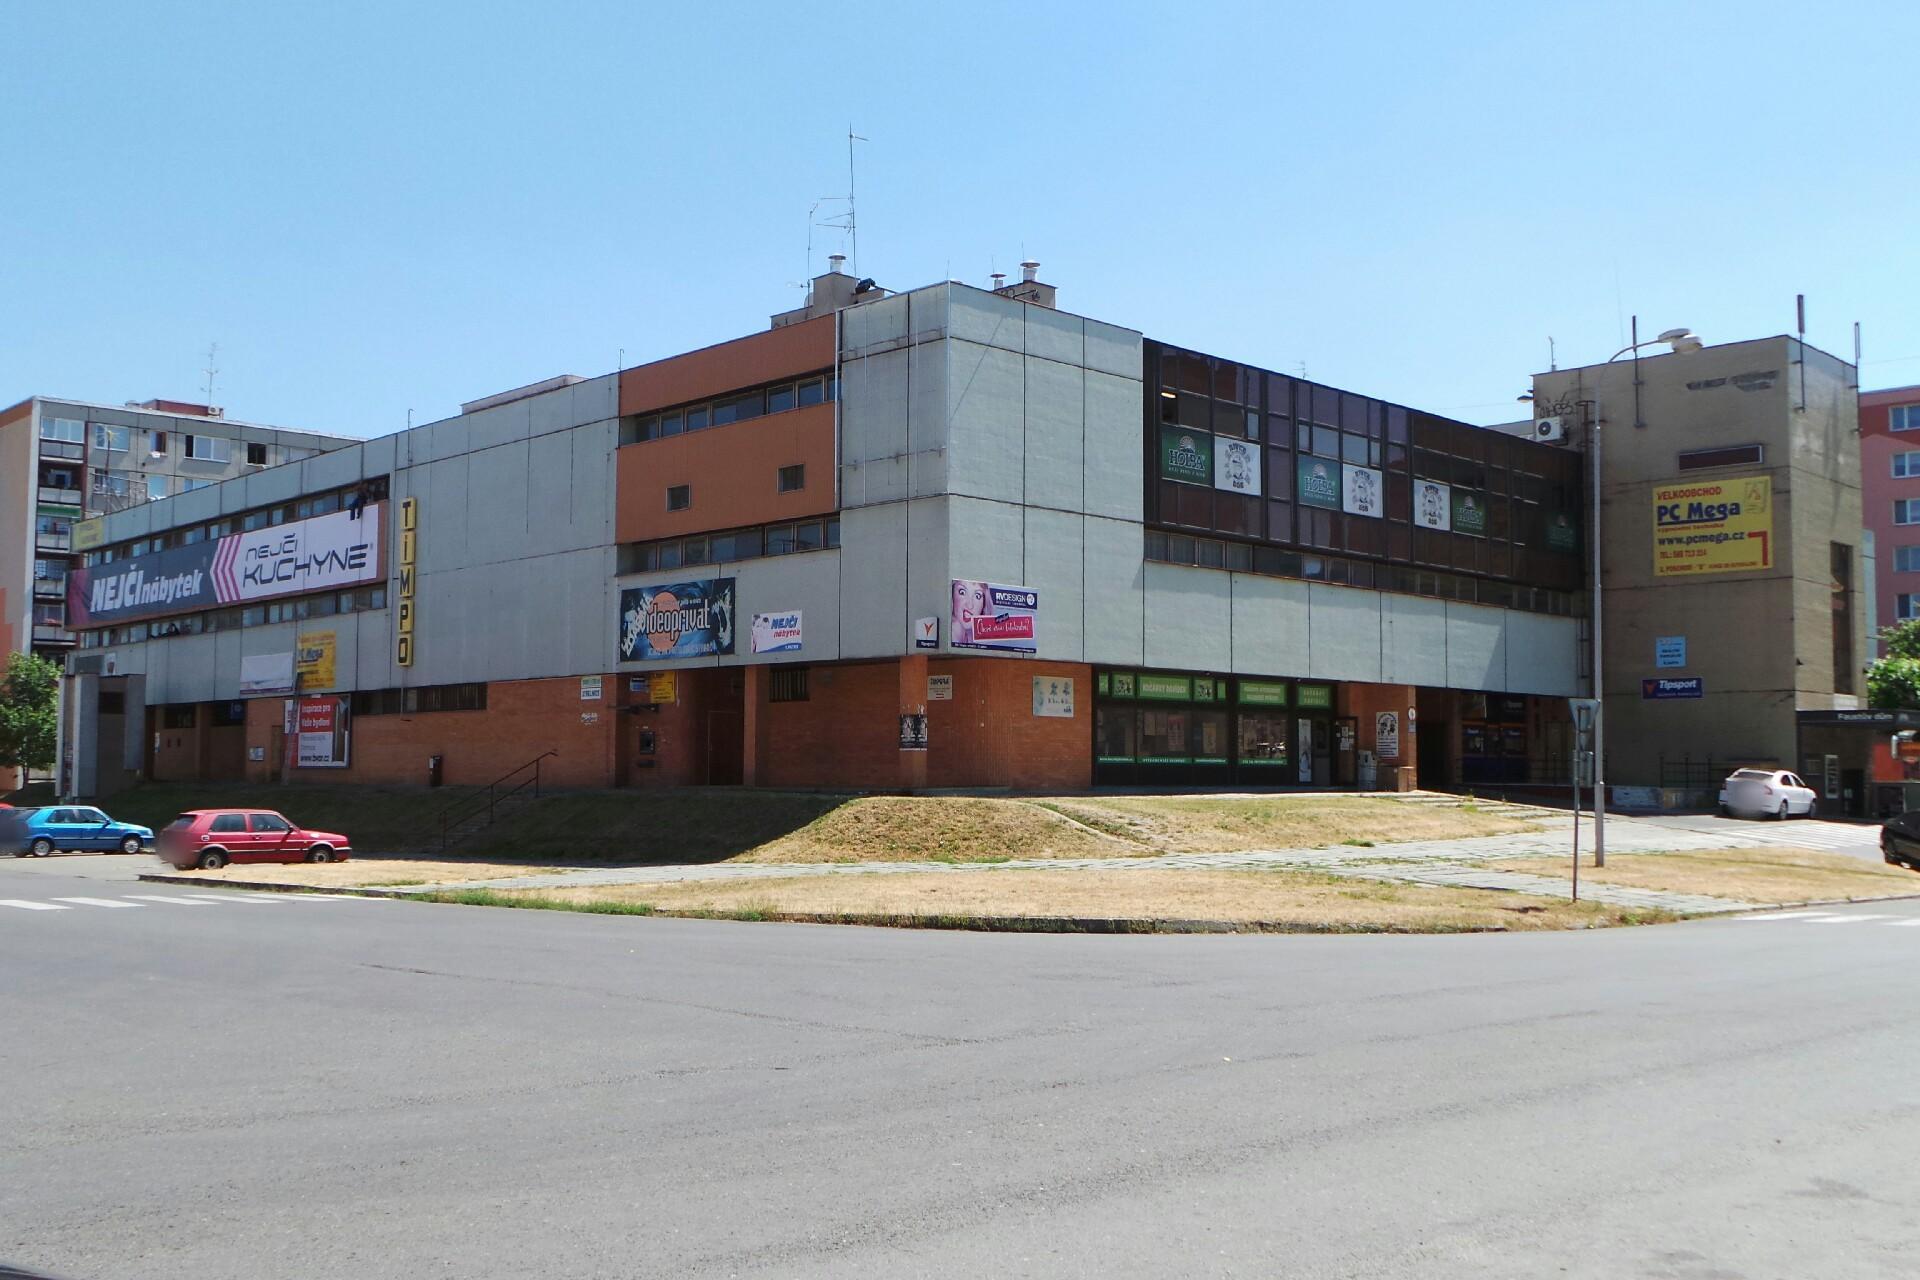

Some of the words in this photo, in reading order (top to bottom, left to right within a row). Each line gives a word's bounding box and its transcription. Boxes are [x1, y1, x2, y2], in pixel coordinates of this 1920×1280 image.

[1657, 486, 1722, 500] VELKOOBCHOD
[1657, 503, 1680, 520] PC
[1688, 502, 1740, 520] Mega
[1658, 532, 1744, 545] www.pcmega.cz
[90, 563, 144, 612] NEJČI
[141, 569, 203, 604] nábytek
[398, 501, 411, 663] TIMPO
[1660, 679, 1696, 690] Tipsport
